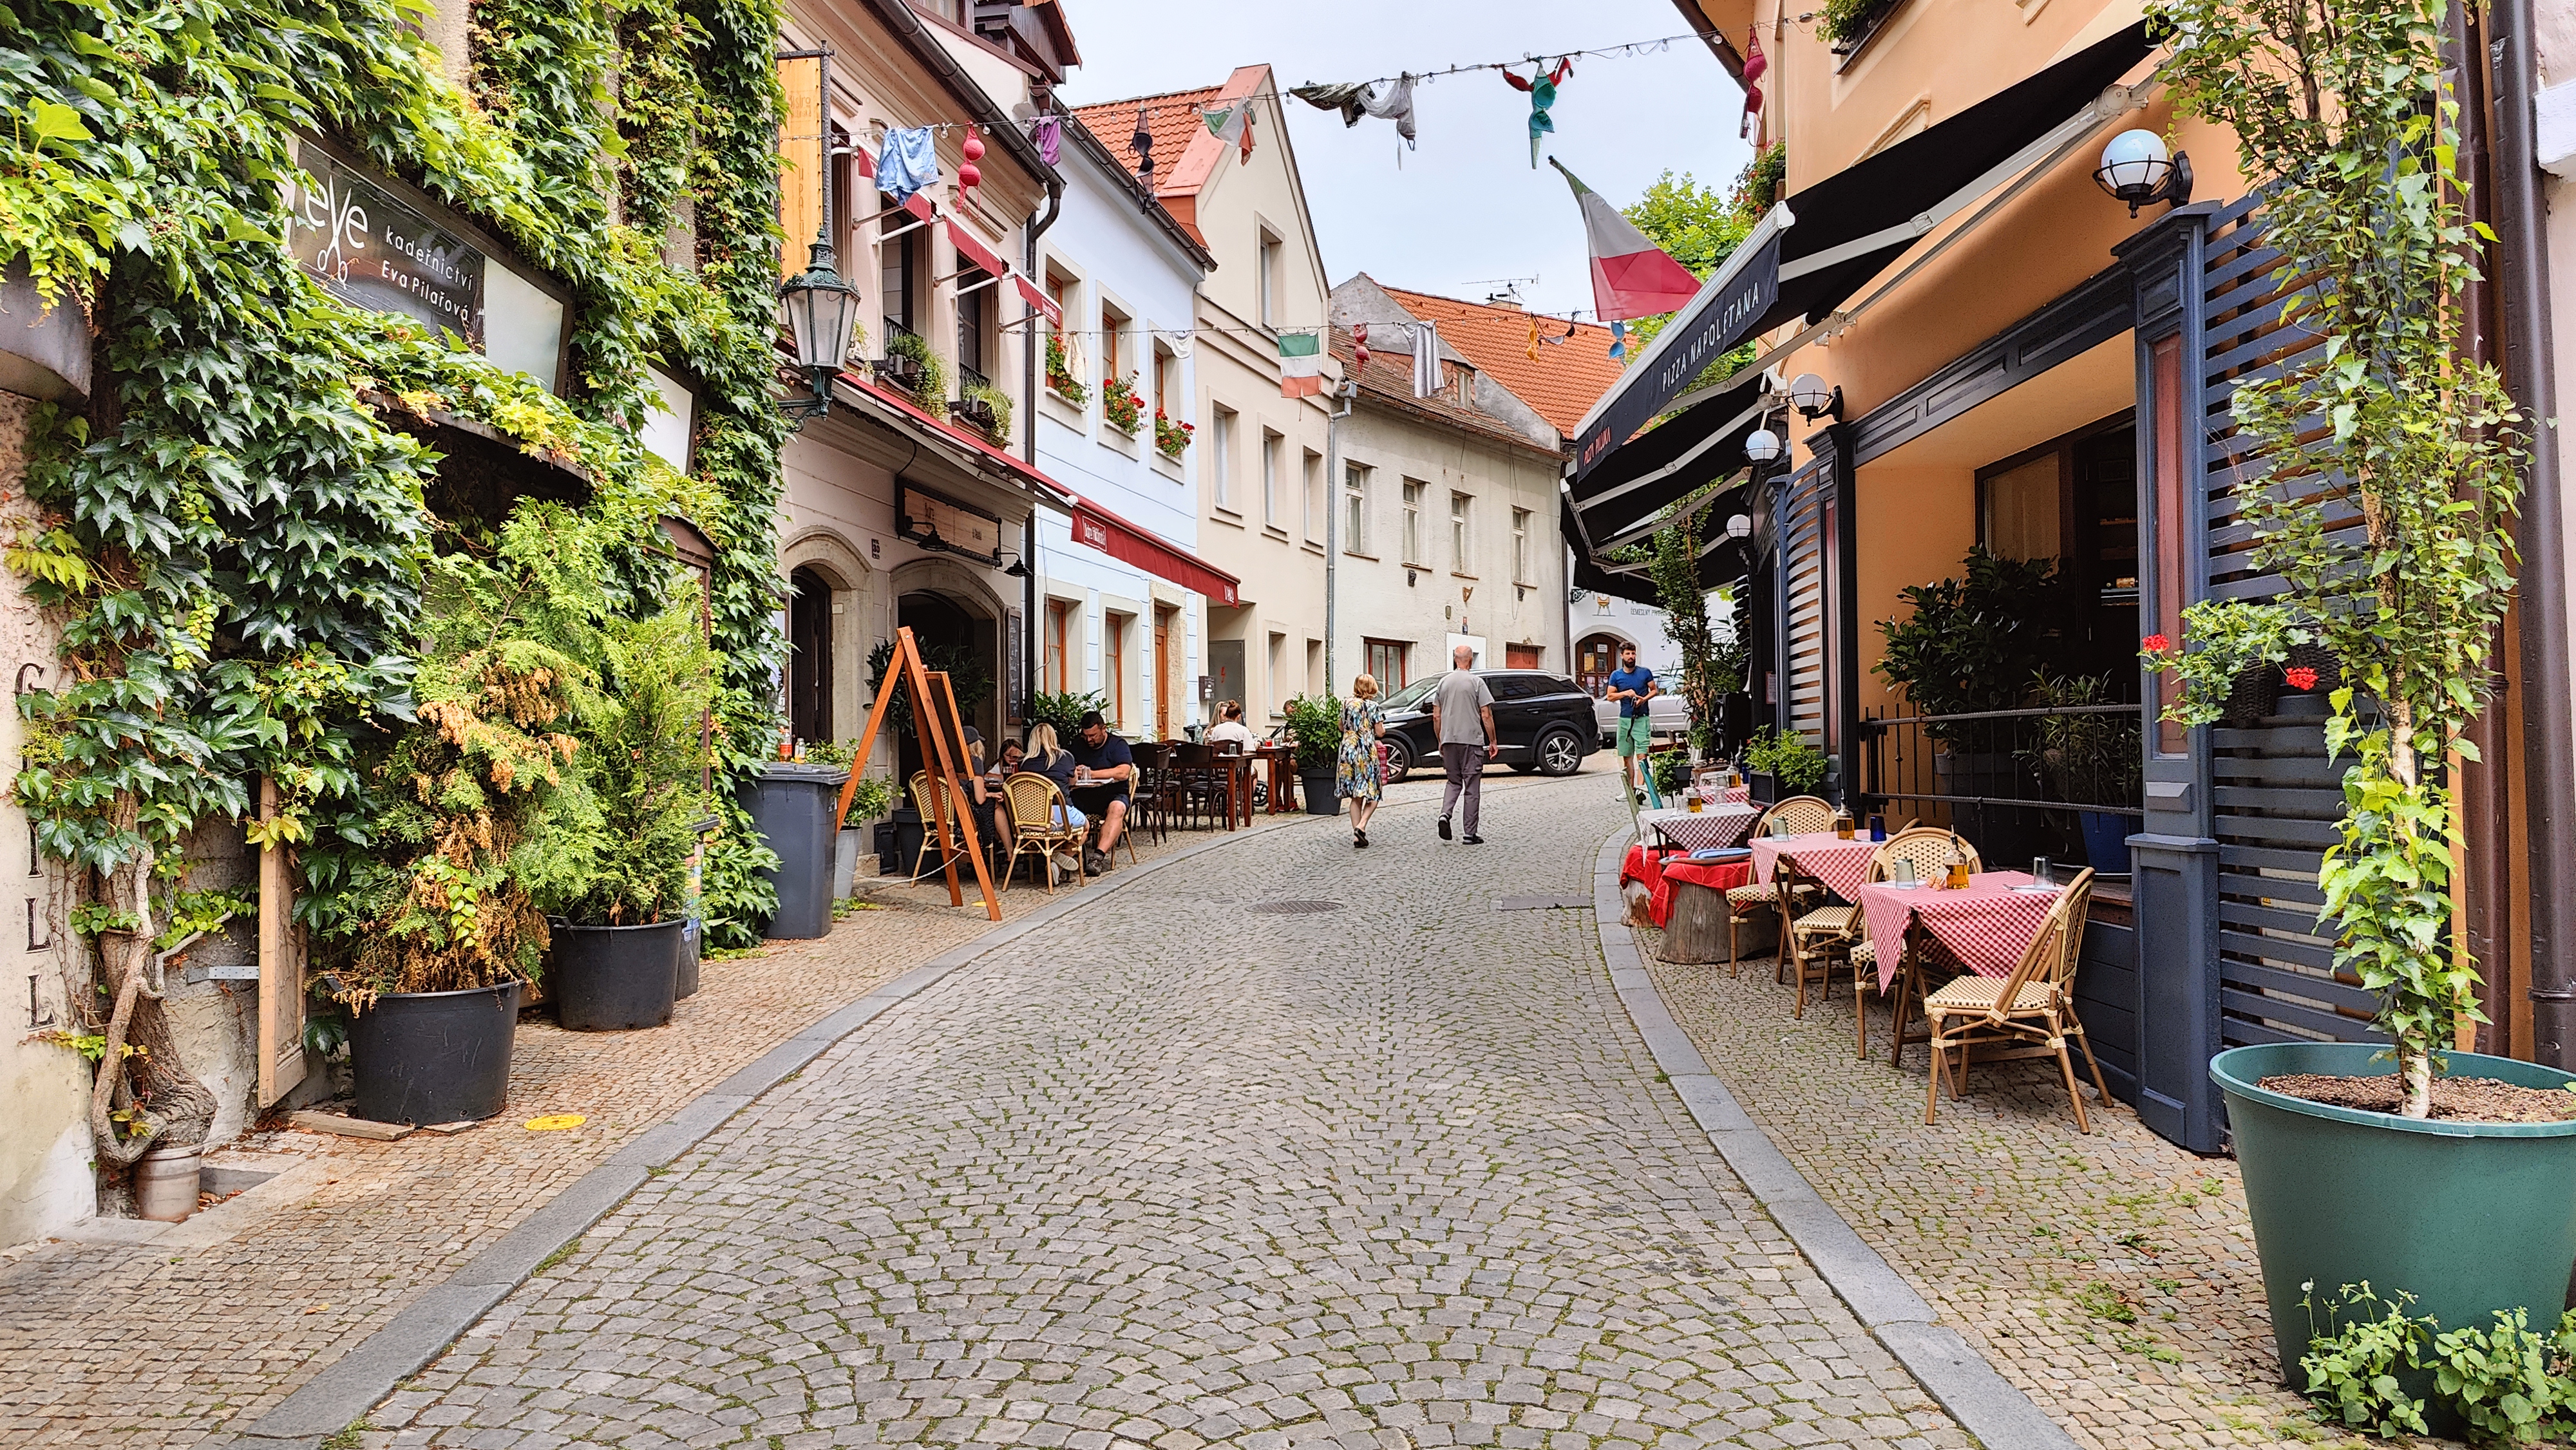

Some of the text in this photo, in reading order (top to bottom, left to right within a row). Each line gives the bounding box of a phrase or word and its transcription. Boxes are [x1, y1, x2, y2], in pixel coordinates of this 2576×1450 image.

[381, 259, 469, 321] Eva Pilařová
[386, 225, 473, 292] kadeřnictví
[1662, 281, 1759, 392] PIZZA NAPOLETANA
[15, 663, 57, 1032] GILL
